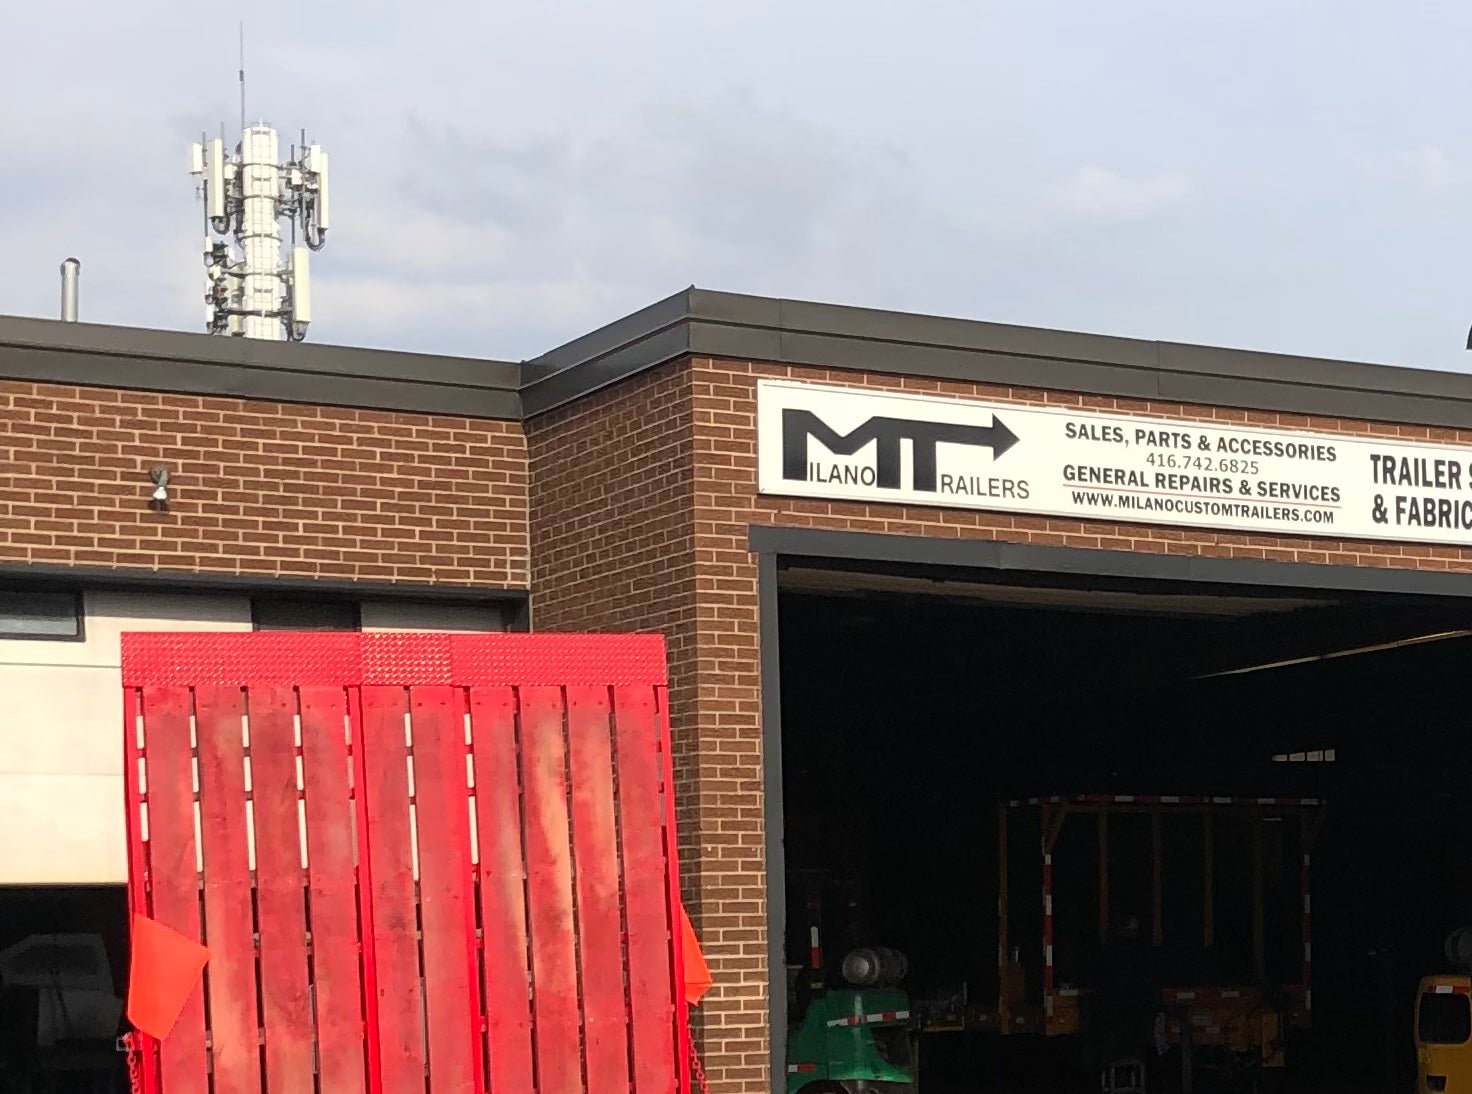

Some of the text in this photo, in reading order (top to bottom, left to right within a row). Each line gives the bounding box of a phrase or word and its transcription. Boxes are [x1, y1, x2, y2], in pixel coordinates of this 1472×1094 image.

[1065, 422, 1337, 462] SALES, PARTS & ACCESSORIES
[1146, 452, 1259, 475] 416.742.6825
[1370, 454, 1462, 490] TRAILER
[1063, 464, 1340, 502] GENERAL REPAIRS & SERVICES
[1072, 490, 1334, 524] WWW.MILANOCUSTOMTRAILERS.COM
[1372, 494, 1388, 525] &
